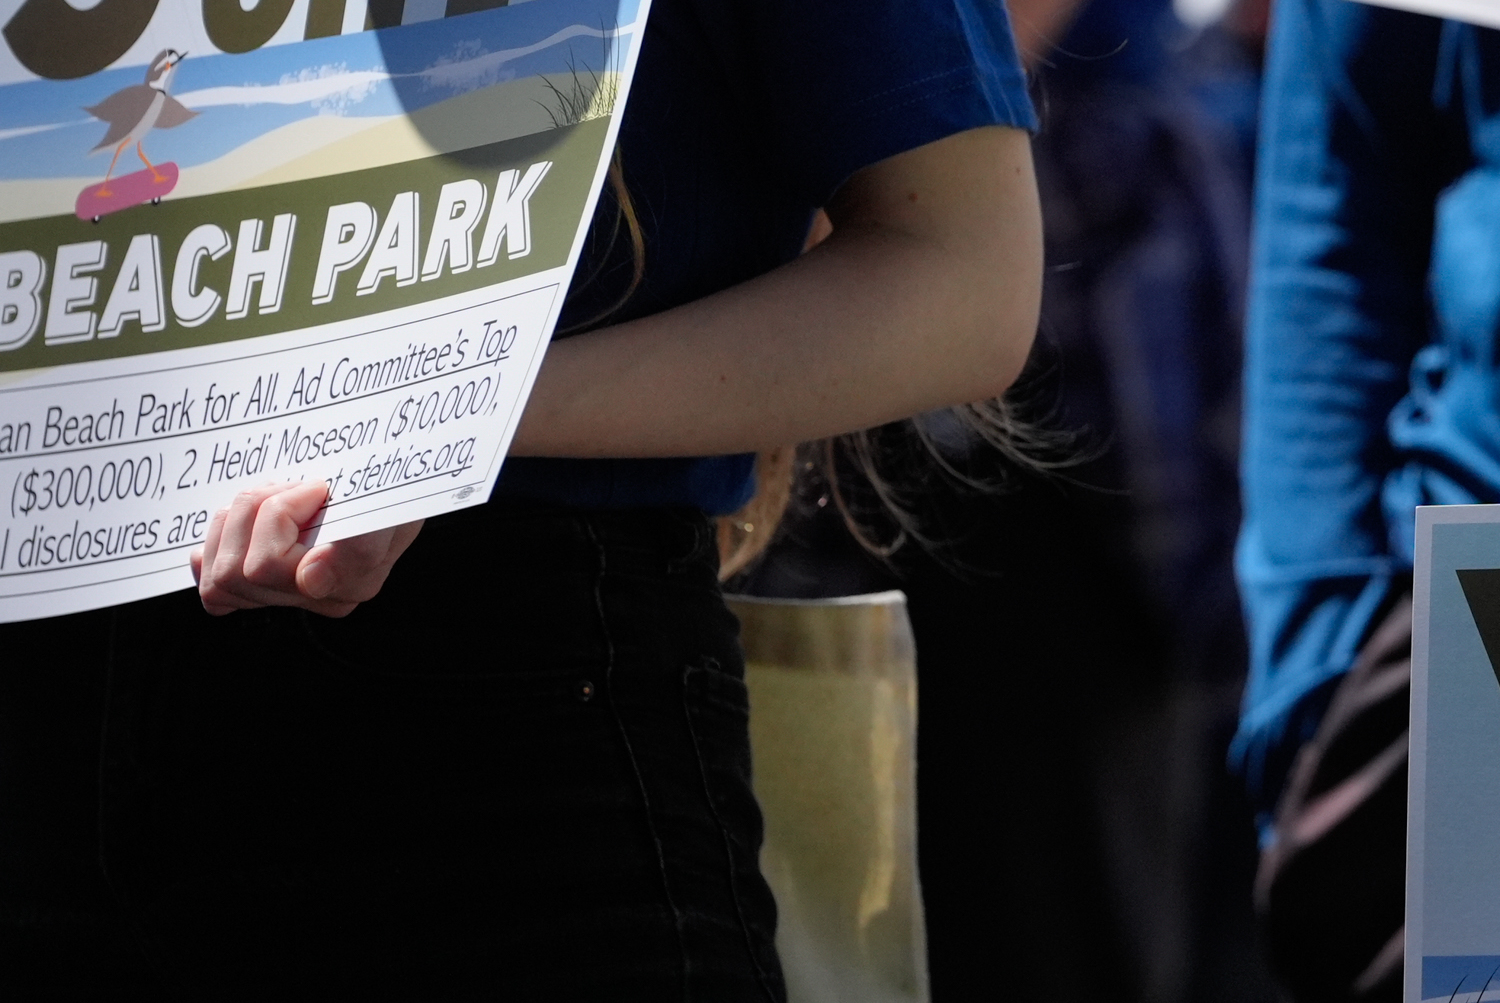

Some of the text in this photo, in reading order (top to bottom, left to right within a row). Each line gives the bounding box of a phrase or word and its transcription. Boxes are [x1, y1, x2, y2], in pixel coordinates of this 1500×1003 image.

[0, 159, 554, 353] BEACH PARK
[11, 372, 501, 519] ($300,000), 2. Heidi Moseson ($10,000),
[42, 397, 124, 449] Beach
[135, 386, 195, 437] Park
[202, 383, 240, 426] for
[243, 371, 279, 419] All.
[286, 362, 325, 409] Ad
[477, 319, 518, 367] Top
[18, 519, 161, 569] disclosures
[167, 508, 208, 545] are
[343, 436, 477, 498] sfethics.org.
